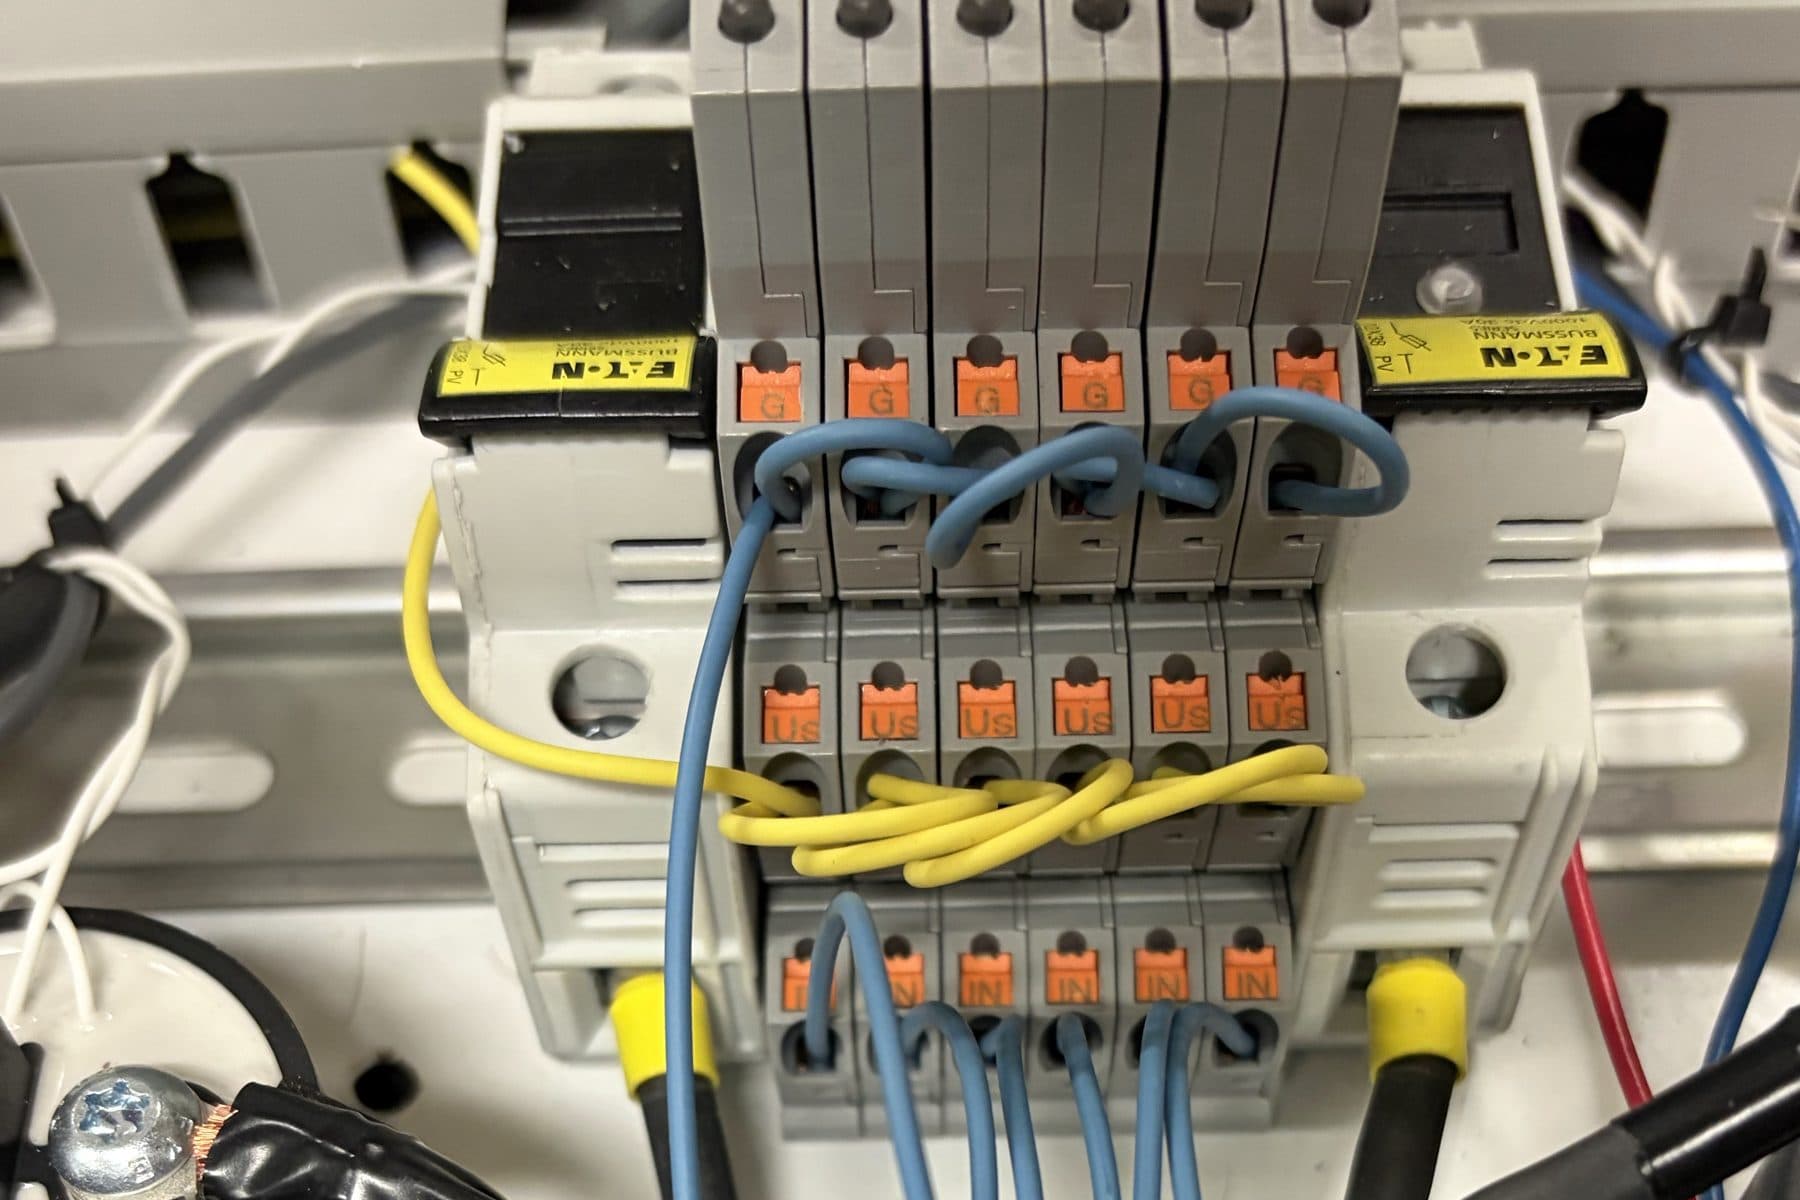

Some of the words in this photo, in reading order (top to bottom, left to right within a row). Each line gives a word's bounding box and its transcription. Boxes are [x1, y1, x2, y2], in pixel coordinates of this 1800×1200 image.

[1472, 329, 1599, 340] BUSSMANN
[1375, 356, 1394, 372] PV
[447, 370, 464, 385] PV
[1190, 377, 1215, 402] G
[761, 392, 785, 419] G
[871, 388, 894, 415] G
[976, 386, 1000, 415] G
[1083, 383, 1109, 409] G
[969, 981, 1000, 1003] IN
[1058, 978, 1092, 1001] IN
[1147, 974, 1181, 998] IN
[1236, 971, 1270, 996] IN
